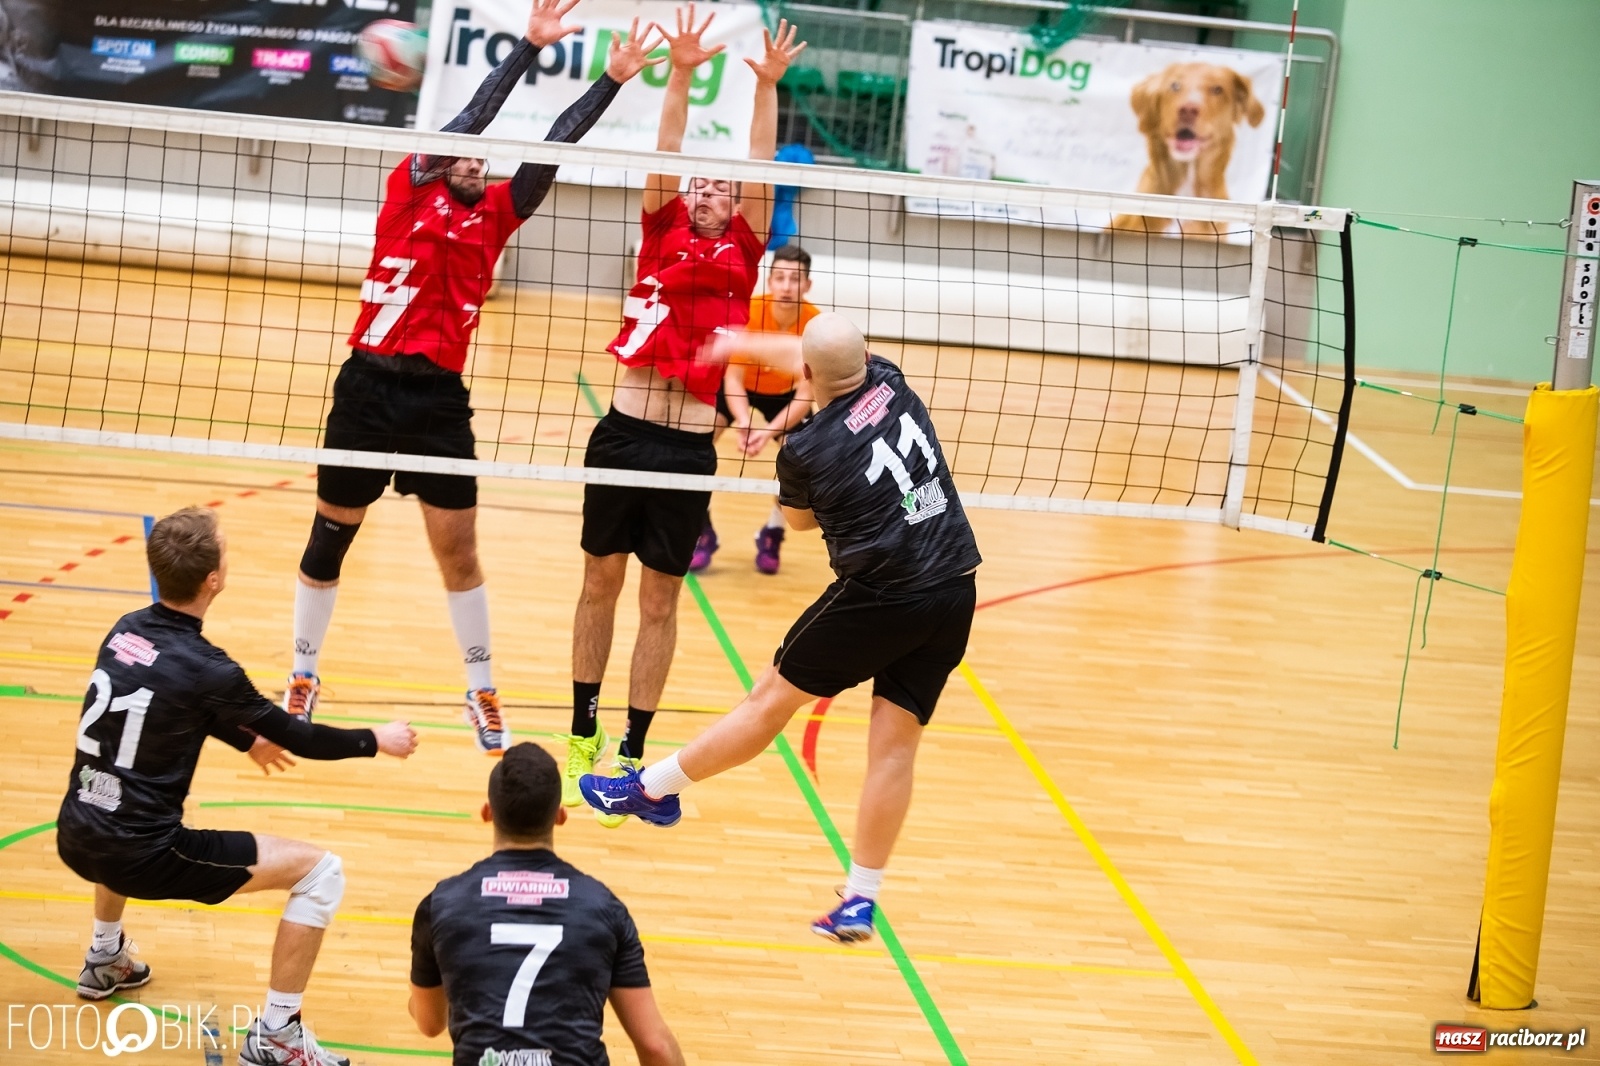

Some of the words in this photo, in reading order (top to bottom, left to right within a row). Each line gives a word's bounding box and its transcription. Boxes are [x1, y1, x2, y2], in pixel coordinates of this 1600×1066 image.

[96, 38, 130, 54] SPOT
[131, 41, 153, 57] ON
[178, 45, 229, 62] COMBO
[254, 50, 308, 67] TRI-ACT
[934, 37, 1092, 92] TropiDog
[849, 388, 891, 428] PIWIARNIA
[865, 412, 938, 494] 11
[76, 669, 155, 770] 21
[488, 880, 563, 894] PIWIARNIA
[491, 923, 563, 1028] 7
